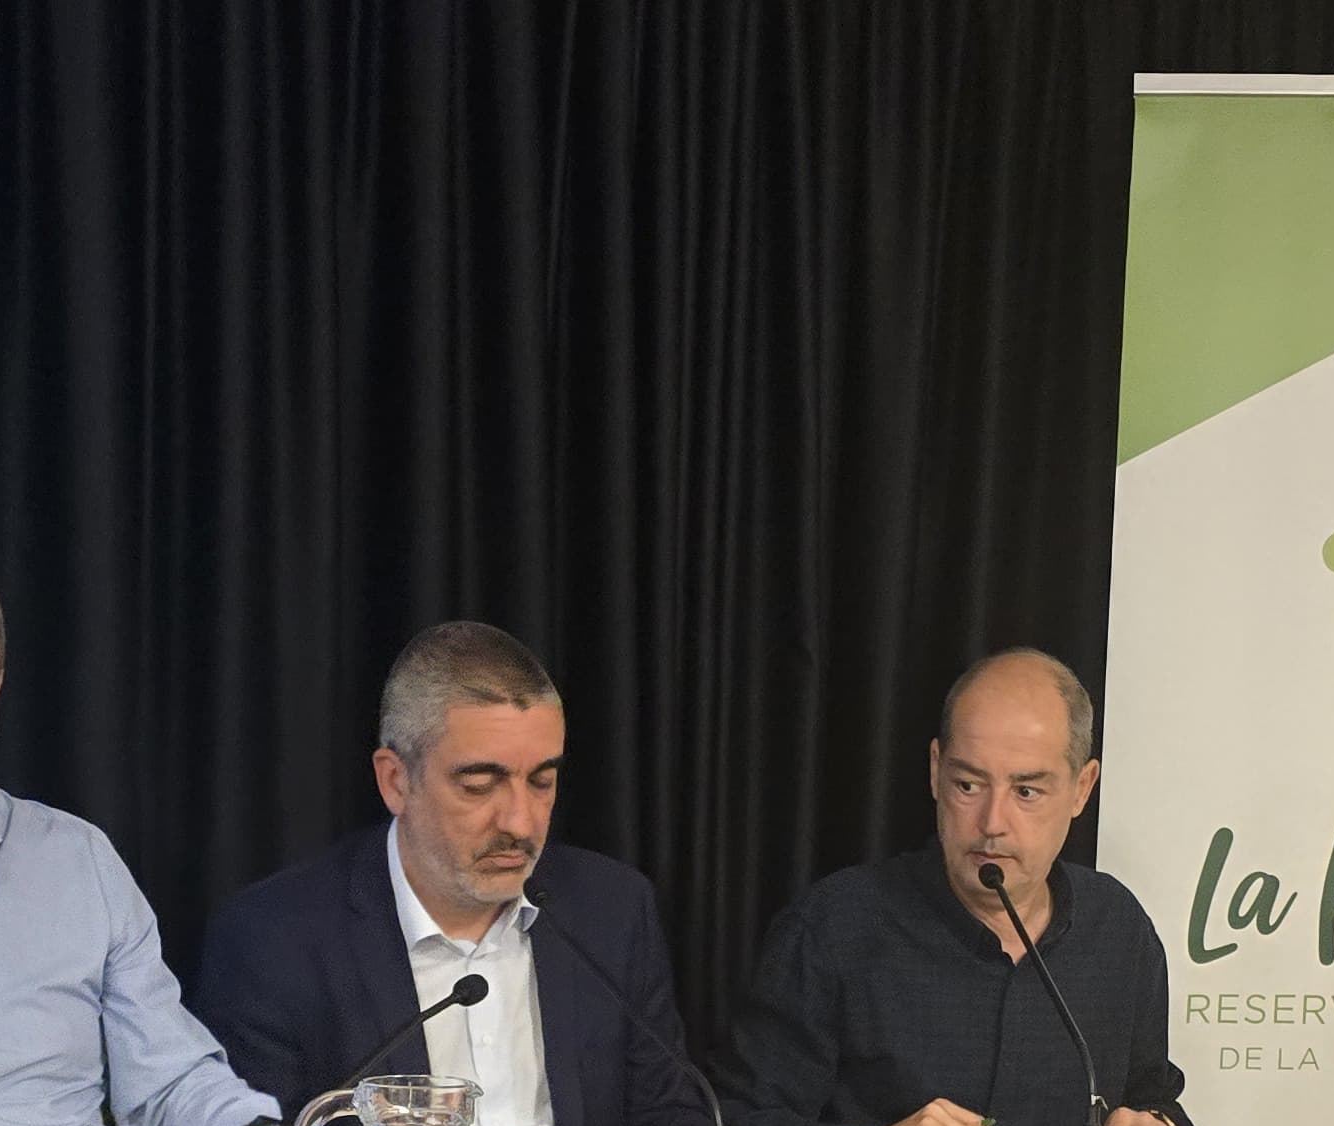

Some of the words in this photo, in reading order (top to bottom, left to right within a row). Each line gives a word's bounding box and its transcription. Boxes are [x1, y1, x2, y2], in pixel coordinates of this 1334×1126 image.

[1187, 826, 1299, 966] La
[1218, 1046, 1264, 1072] DE
[1276, 1046, 1321, 1072] LA
